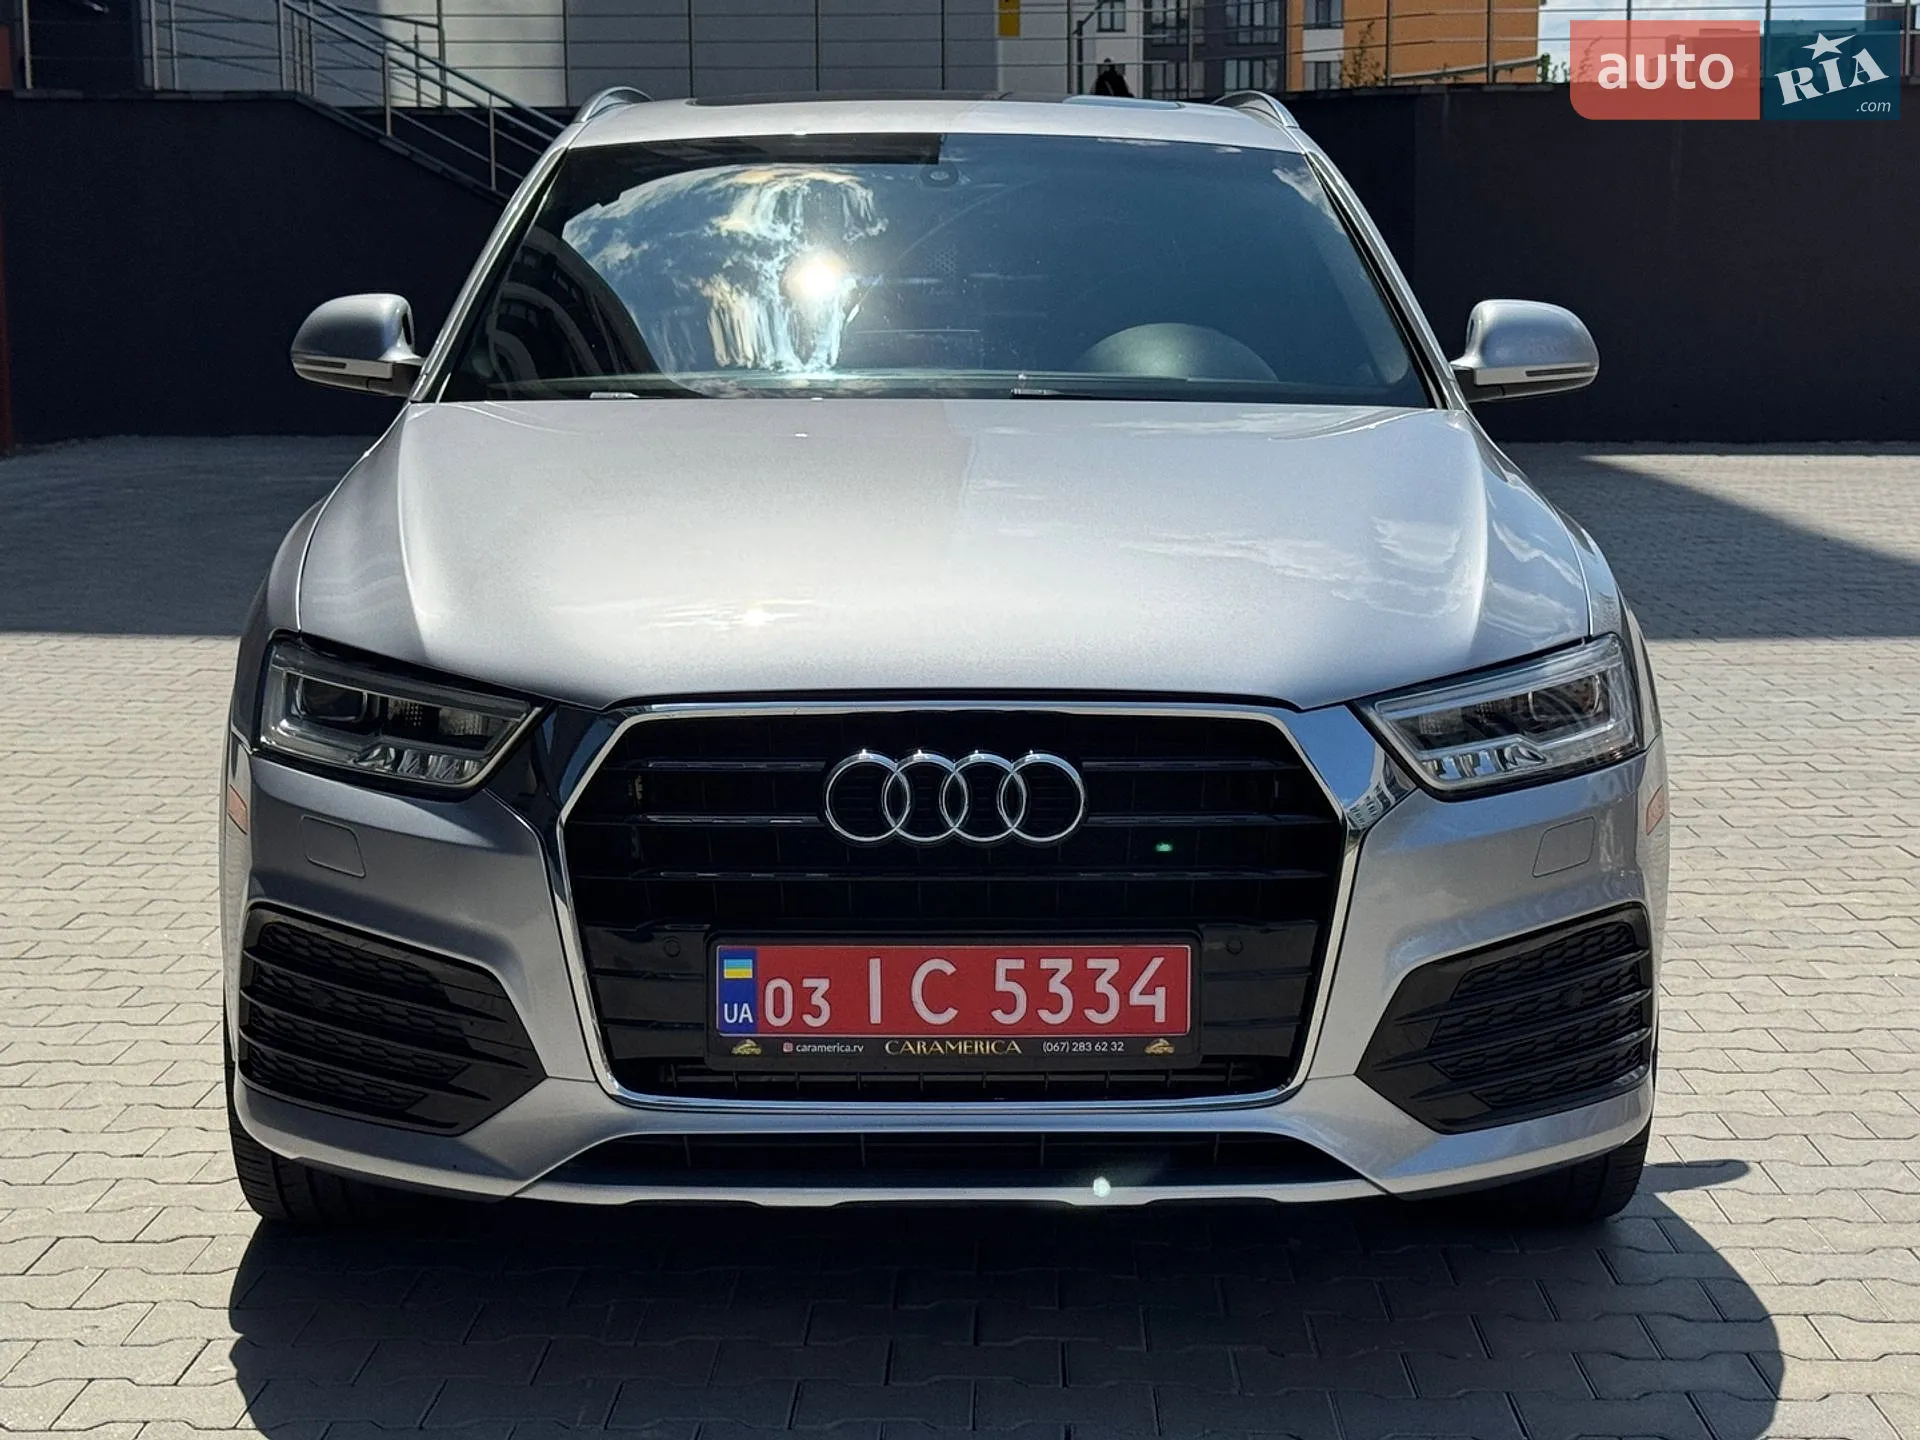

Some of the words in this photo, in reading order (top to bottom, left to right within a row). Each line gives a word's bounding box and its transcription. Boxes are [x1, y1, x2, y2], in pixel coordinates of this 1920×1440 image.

[763, 977, 832, 1028] 03
[990, 956, 1168, 1025] 5334
[723, 1002, 754, 1024] UA
[795, 1042, 864, 1053] caramerica.rv
[884, 1039, 1023, 1056] CARAMERICA
[1042, 1040, 1070, 1054] (067)
[1071, 1041, 1092, 1052] 283
[1094, 1041, 1108, 1052] 62
[1110, 1041, 1125, 1052] 32
